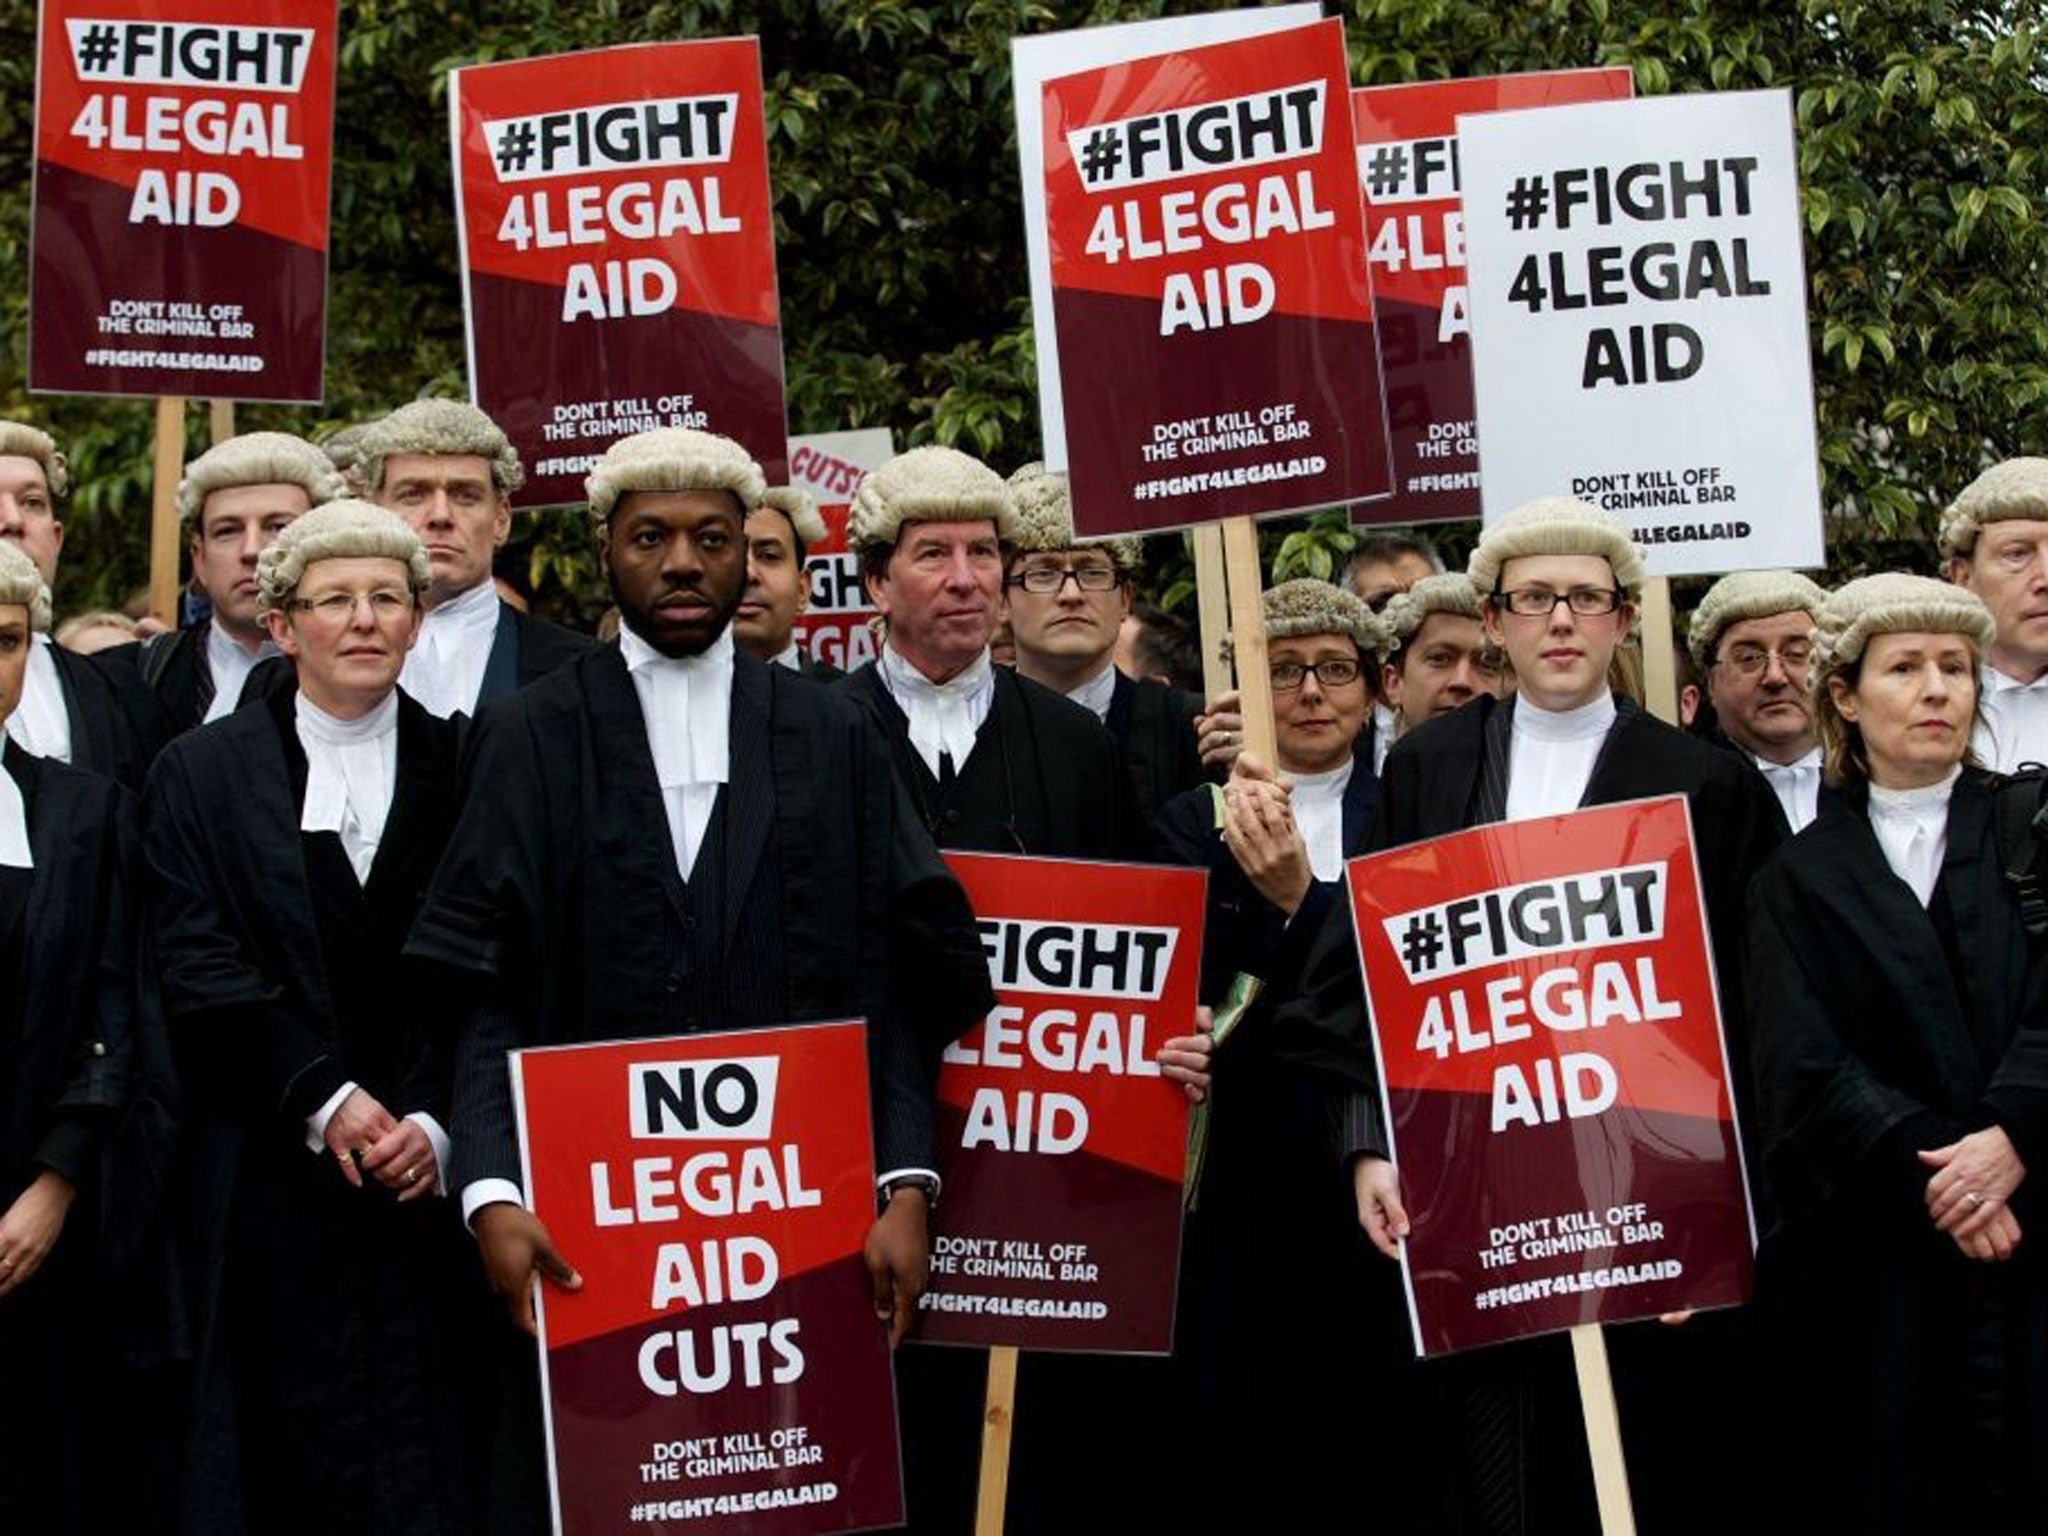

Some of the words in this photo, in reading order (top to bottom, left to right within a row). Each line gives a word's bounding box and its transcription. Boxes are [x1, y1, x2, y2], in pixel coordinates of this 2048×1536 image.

[78, 24, 303, 86] #FIGHT
[70, 95, 304, 159] 4LEGAL
[497, 100, 729, 172] #FIGHT
[1081, 88, 1318, 183] #FIGHT
[129, 170, 240, 227] AID
[497, 177, 741, 250] 4LEGAL
[1085, 170, 1333, 264] 4LEGAL
[1506, 157, 1758, 230] #FIGHT
[562, 259, 677, 323] AID
[1159, 262, 1276, 336] AID
[1507, 237, 1771, 313] 4LEGAL
[98, 316, 131, 333] THE
[135, 318, 216, 337] CRIMINAL
[219, 322, 254, 338] BAR
[110, 300, 165, 317] DON'T
[169, 303, 205, 320] KILL
[209, 305, 243, 320] OFF
[85, 350, 264, 372] #FIGHT4LEGALAID
[1581, 323, 1704, 389] AID
[542, 423, 577, 441] THE
[580, 415, 662, 437] CRIMINAL
[670, 411, 708, 428] BAR
[554, 402, 609, 422] DON'T
[613, 398, 653, 416] KILL
[657, 395, 693, 413] OFF
[1154, 417, 1210, 442] DON'T
[1215, 411, 1255, 432] KILL
[1260, 404, 1295, 426] OFF
[1142, 441, 1178, 462] THE
[1182, 428, 1269, 456] CRIMINAL
[1273, 421, 1311, 442] BAR
[1416, 440, 1451, 458] THE
[1134, 456, 1326, 500] #FIGHT4LEGALAID
[1573, 474, 1631, 495] DON'T
[1637, 470, 1677, 489] KILL
[1683, 467, 1720, 486] OFF
[1601, 489, 1691, 511] CRIMINAL
[1697, 485, 1736, 503] BAR
[1402, 868, 1659, 976] #FIGHT
[1415, 956, 1681, 1060] 4LEGAL
[643, 1063, 758, 1135] NO
[1490, 1051, 1618, 1133] AID
[961, 1087, 1089, 1155] AID
[591, 1144, 821, 1228] LEGAL
[935, 1236, 997, 1257] DON'T
[1002, 1241, 1044, 1261] KILL
[1049, 1244, 1087, 1263] OFF
[1479, 1246, 1517, 1270] THE
[1521, 1229, 1618, 1260] CRIMINAL
[1622, 1222, 1664, 1245] BAR
[1490, 1218, 1551, 1247] DON'T
[1557, 1211, 1600, 1234] KILL
[1606, 1203, 1646, 1226] OFF
[650, 1236, 779, 1311] AID
[963, 1258, 1055, 1281] CRIMINAL
[1060, 1263, 1099, 1282] BAR
[1475, 1259, 1684, 1310] #FIGHT4LEGALAID
[637, 1318, 805, 1398] CUTS
[639, 1461, 680, 1483] THE
[685, 1451, 780, 1478] CRIMINAL
[785, 1445, 823, 1467] BAR
[653, 1437, 717, 1462] DON'T
[723, 1433, 765, 1455] KILL
[770, 1427, 808, 1448] OFF
[630, 1482, 838, 1522] #FIGHT4LEGALAID
